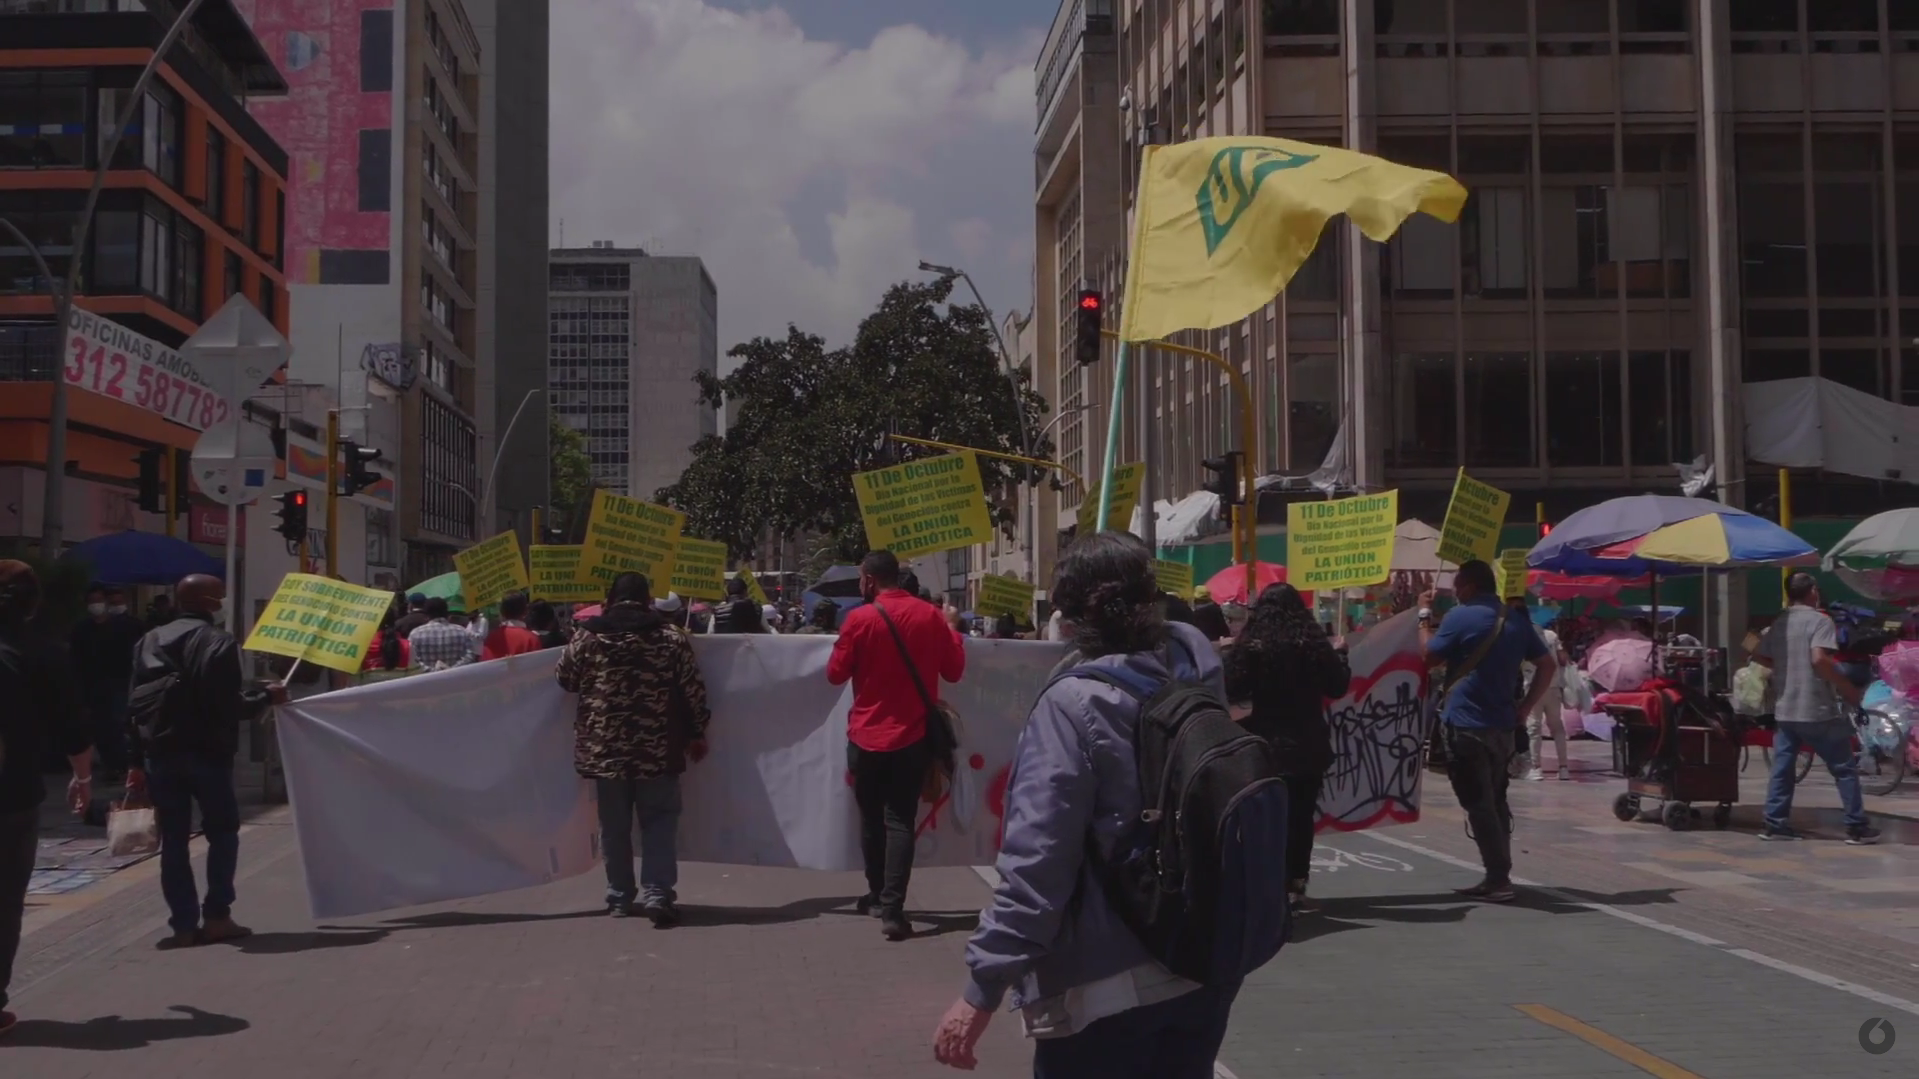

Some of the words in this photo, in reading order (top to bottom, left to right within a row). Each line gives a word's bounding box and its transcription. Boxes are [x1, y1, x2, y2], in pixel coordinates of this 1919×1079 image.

[68, 310, 153, 361] OFICINAS
[65, 336, 128, 398] 312
[864, 472, 879, 489] 11
[880, 470, 902, 486] De
[904, 457, 964, 480] Octubre
[892, 481, 933, 497] Nacional
[934, 477, 951, 488] por
[951, 474, 961, 483] la
[604, 496, 617, 511] 11
[617, 498, 634, 515] De
[636, 502, 676, 526] Octubre
[865, 499, 906, 515] Dignidad
[907, 496, 920, 506] de
[920, 492, 936, 502] las
[877, 515, 892, 527] del
[893, 504, 940, 523] Genocidio
[941, 499, 971, 511] contra
[1301, 504, 1313, 519] 11
[1317, 504, 1335, 518] De
[1338, 497, 1389, 516] Octubre
[892, 525, 911, 538] LA
[913, 514, 959, 533] UNIÓN
[886, 527, 973, 553] PATRIÓTICA
[602, 552, 617, 566] LA
[1315, 557, 1331, 568] LA
[1335, 552, 1376, 566] UNIÓN
[671, 576, 721, 590] ATRIÓTICA
[1305, 565, 1383, 582] PATRIÓTICA
[302, 581, 389, 608] SOBREVIVIENTE
[276, 608, 297, 622] LA
[299, 612, 358, 637] UNIÓN
[255, 625, 359, 658] PATRIÓTICA
